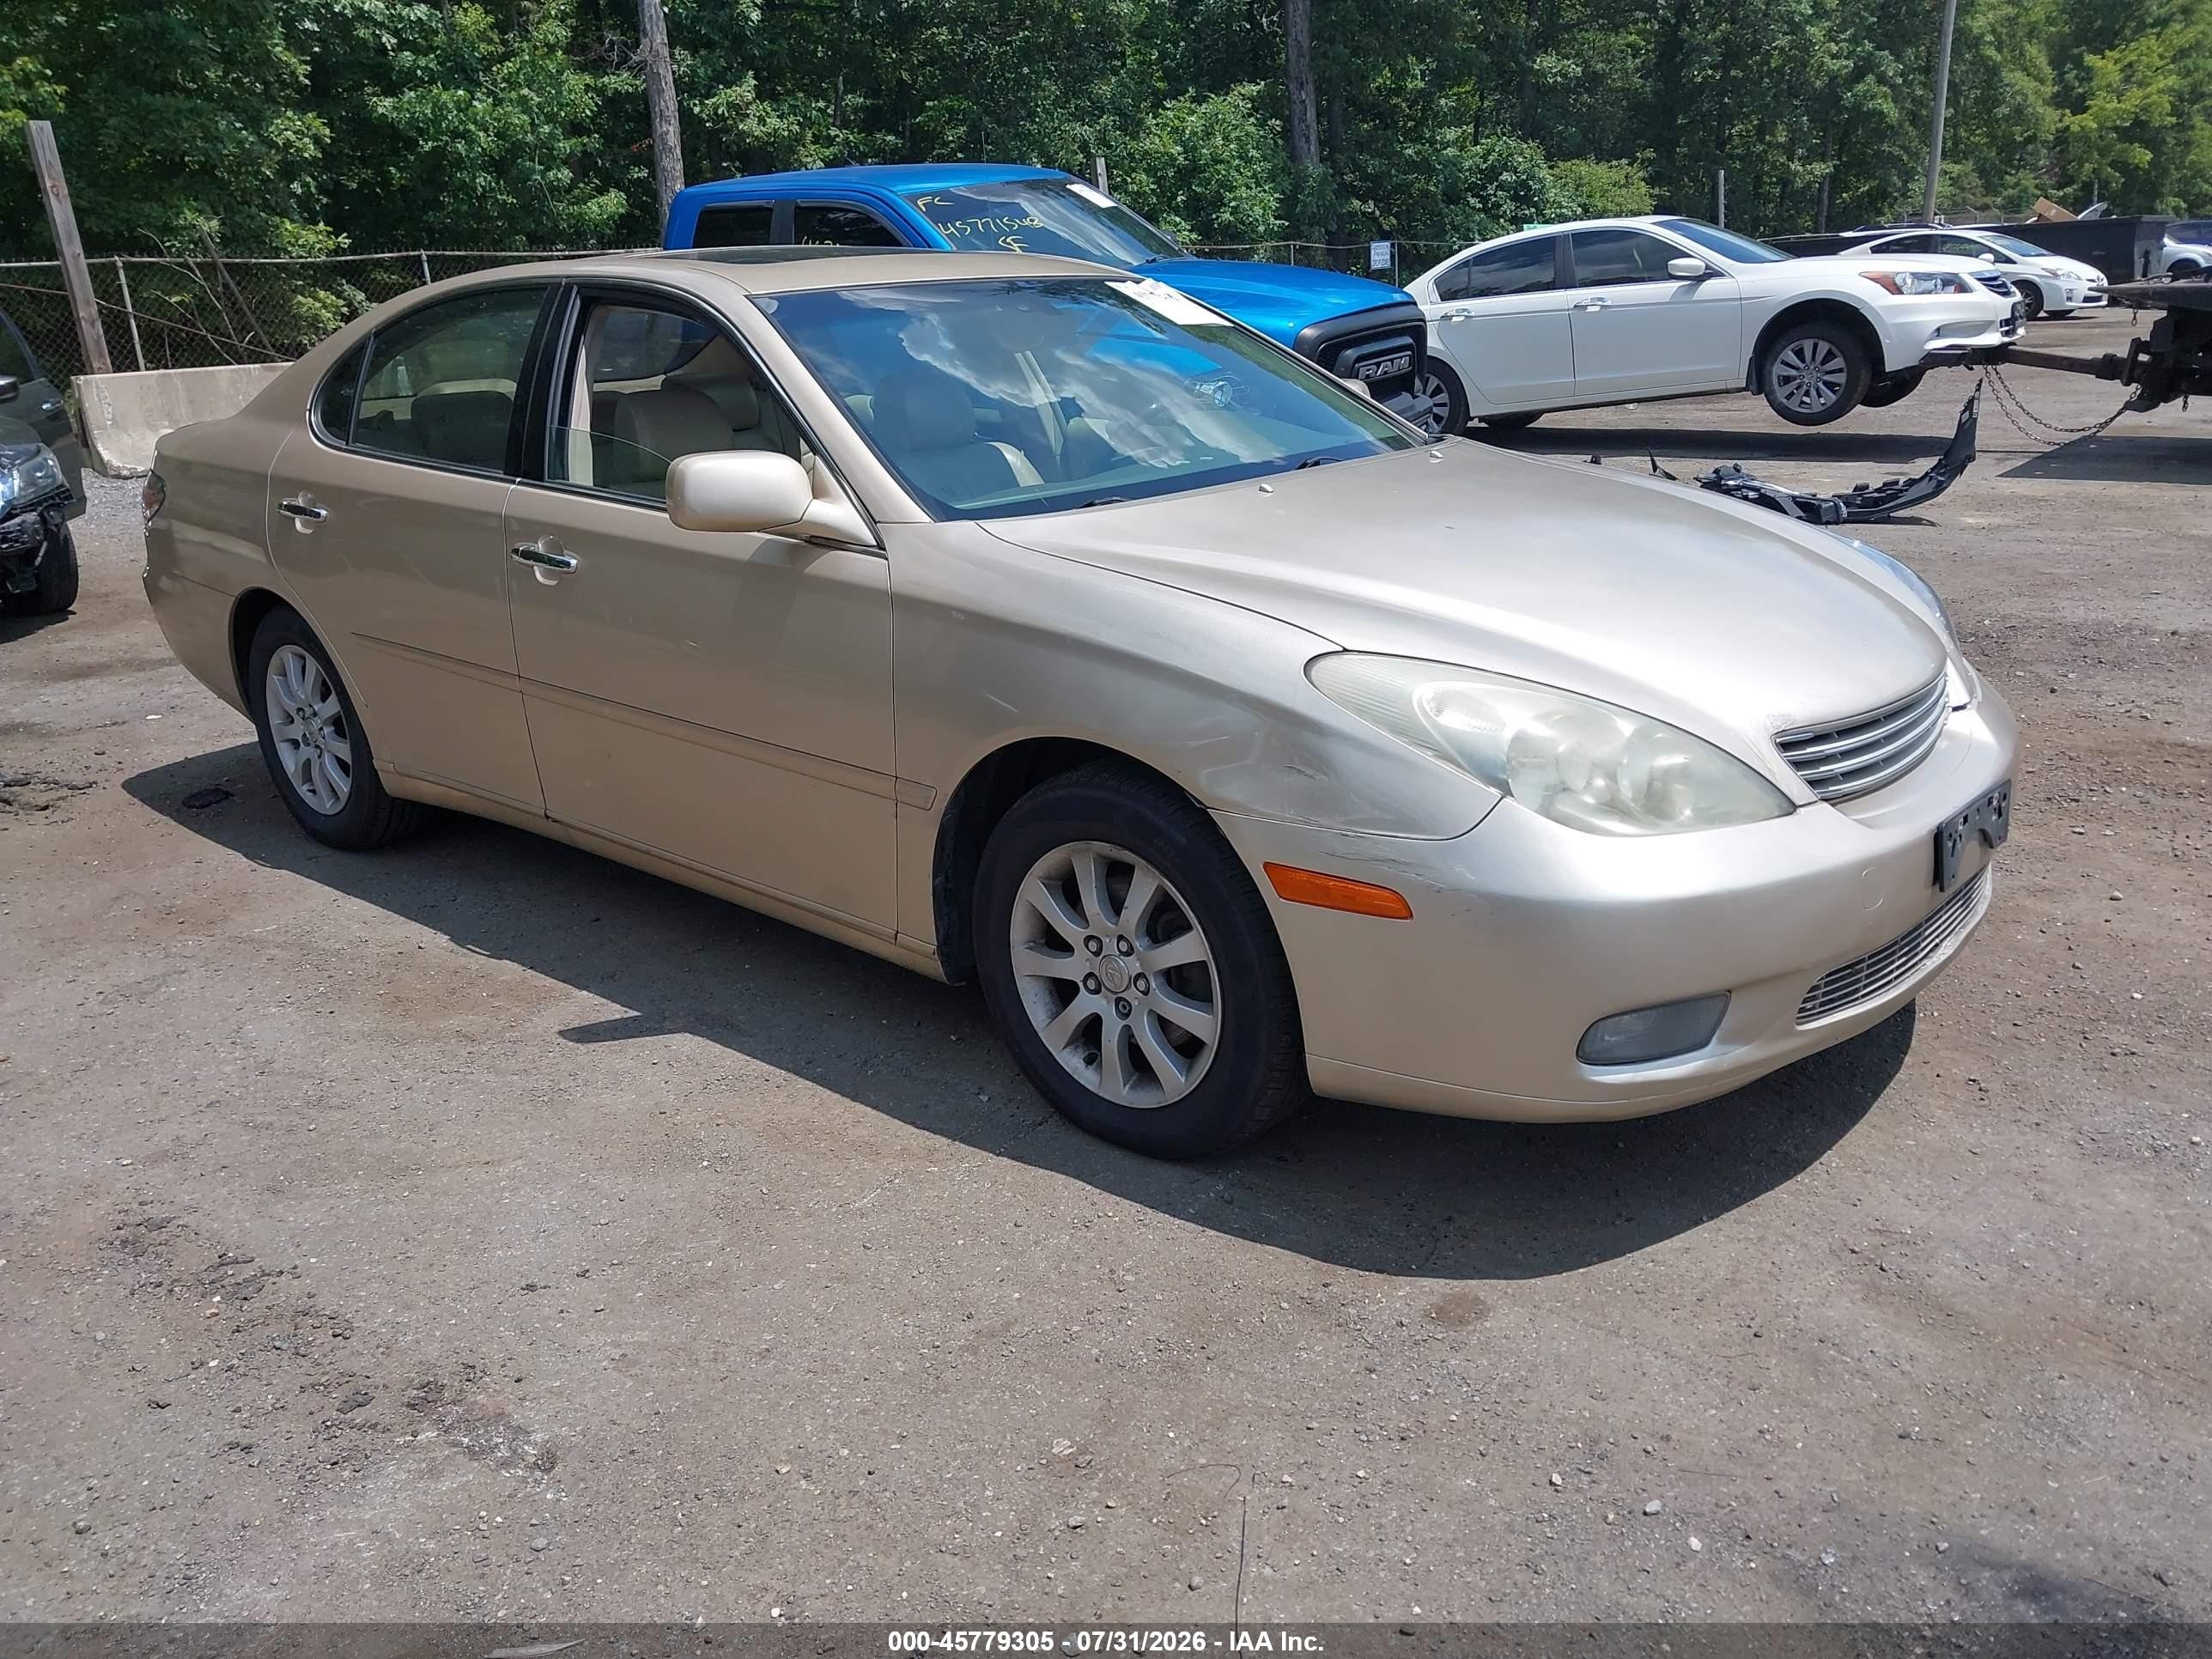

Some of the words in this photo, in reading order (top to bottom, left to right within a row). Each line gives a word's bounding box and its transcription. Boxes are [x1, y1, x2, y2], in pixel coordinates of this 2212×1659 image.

[916, 196, 956, 212] FC
[938, 216, 1044, 238] 45771548
[1358, 356, 1410, 380] RAM
